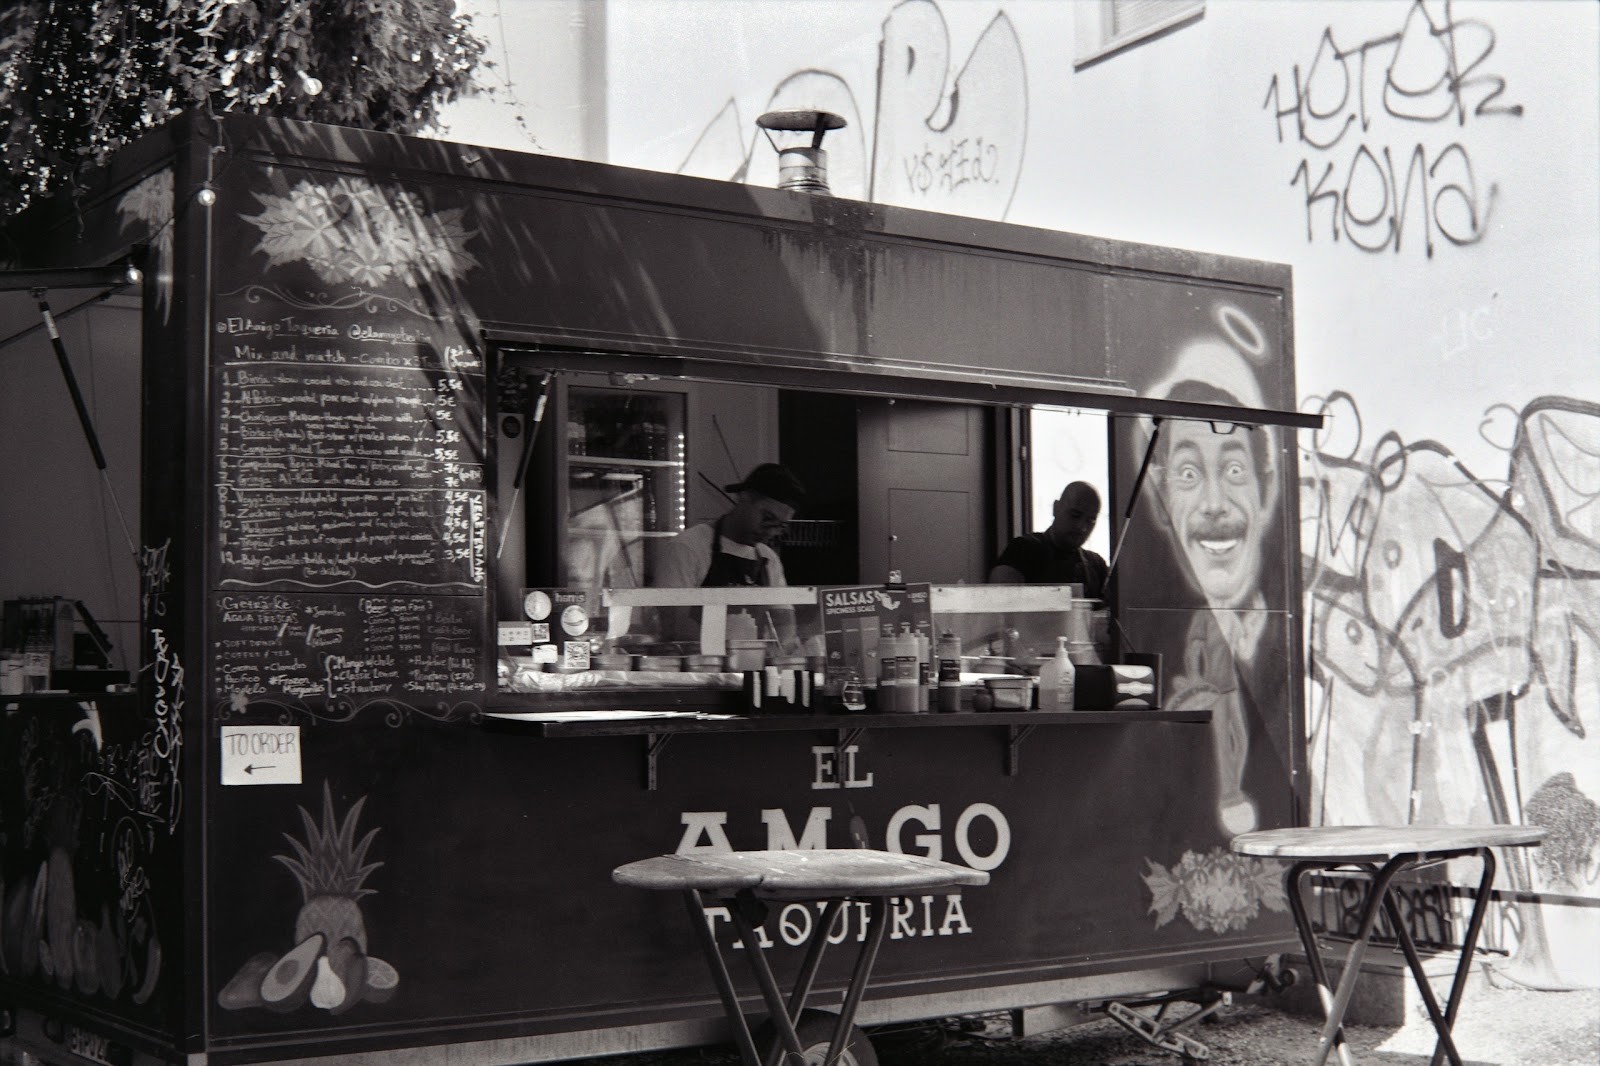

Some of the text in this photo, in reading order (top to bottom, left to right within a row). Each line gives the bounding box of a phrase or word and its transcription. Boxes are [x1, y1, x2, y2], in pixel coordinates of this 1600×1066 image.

[234, 345, 263, 360] Mix
[272, 345, 298, 361] and
[305, 349, 347, 363] match
[825, 590, 875, 607] SALSAS
[224, 732, 296, 756] TO ORDER
[811, 744, 874, 790] EL
[674, 802, 1012, 872] AMGO
